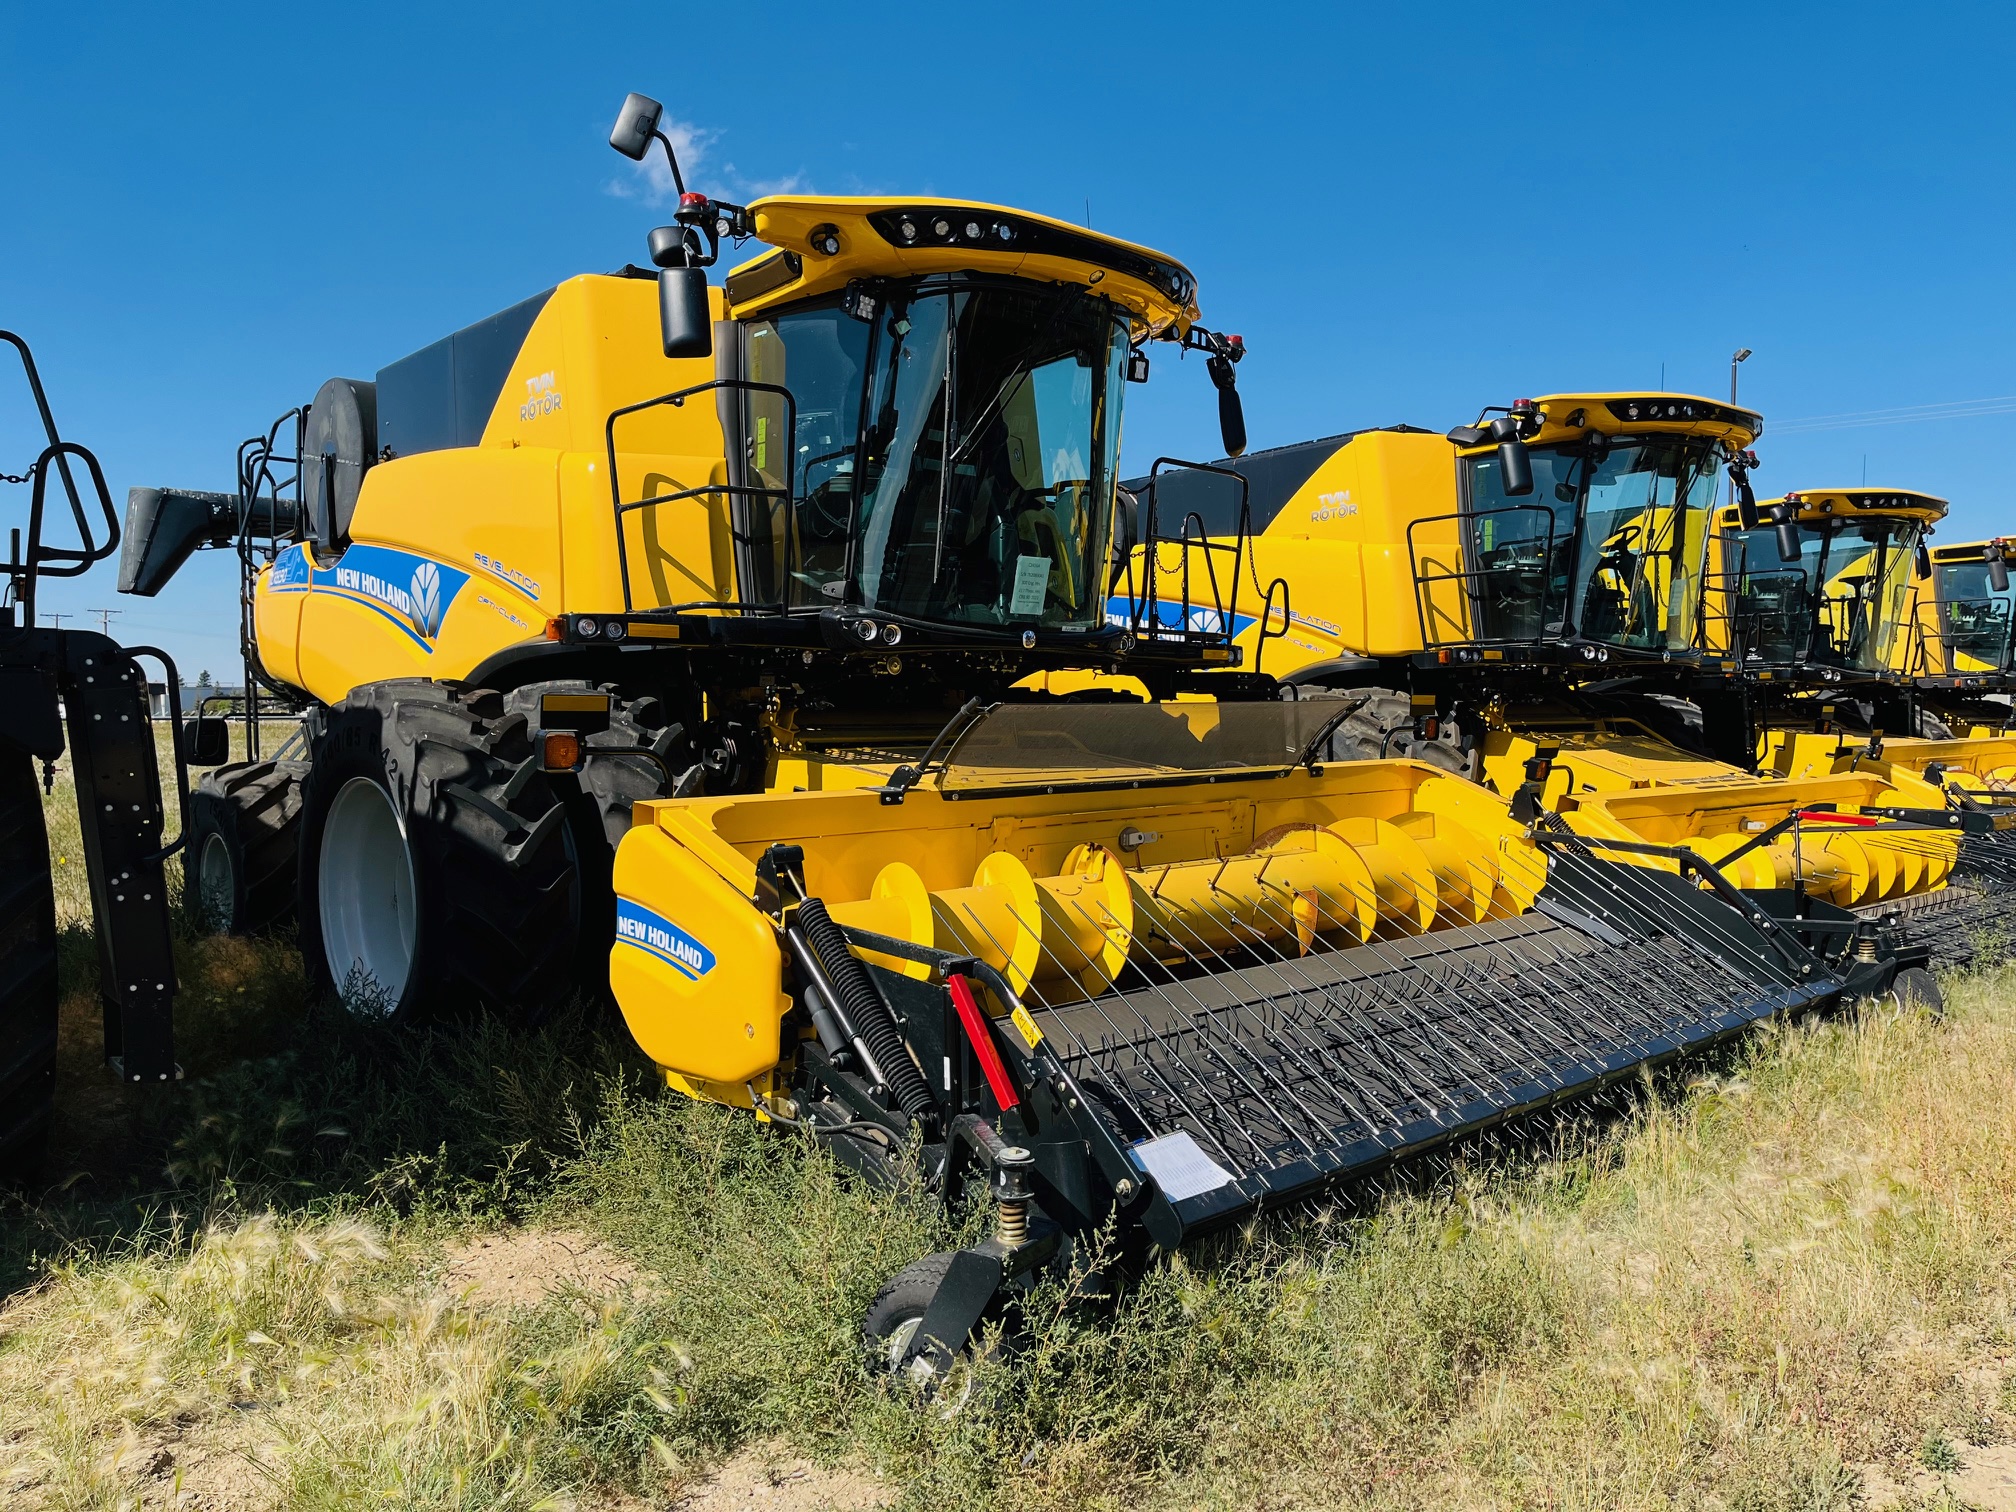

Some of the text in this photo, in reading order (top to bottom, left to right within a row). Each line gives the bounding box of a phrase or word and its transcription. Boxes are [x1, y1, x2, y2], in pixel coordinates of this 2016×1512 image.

[525, 370, 554, 396] TWIN
[520, 391, 562, 422] ROTOR
[1311, 503, 1358, 523] ROTOR
[1317, 489, 1350, 506] TWIN
[474, 552, 541, 595] REVELATION
[336, 567, 411, 614] NEW HOLLAND
[477, 595, 528, 631] OPTI-CLEAN
[1269, 605, 1342, 633] REELATION
[380, 747, 398, 782] 42
[618, 915, 703, 970] NEW HOLLAND
